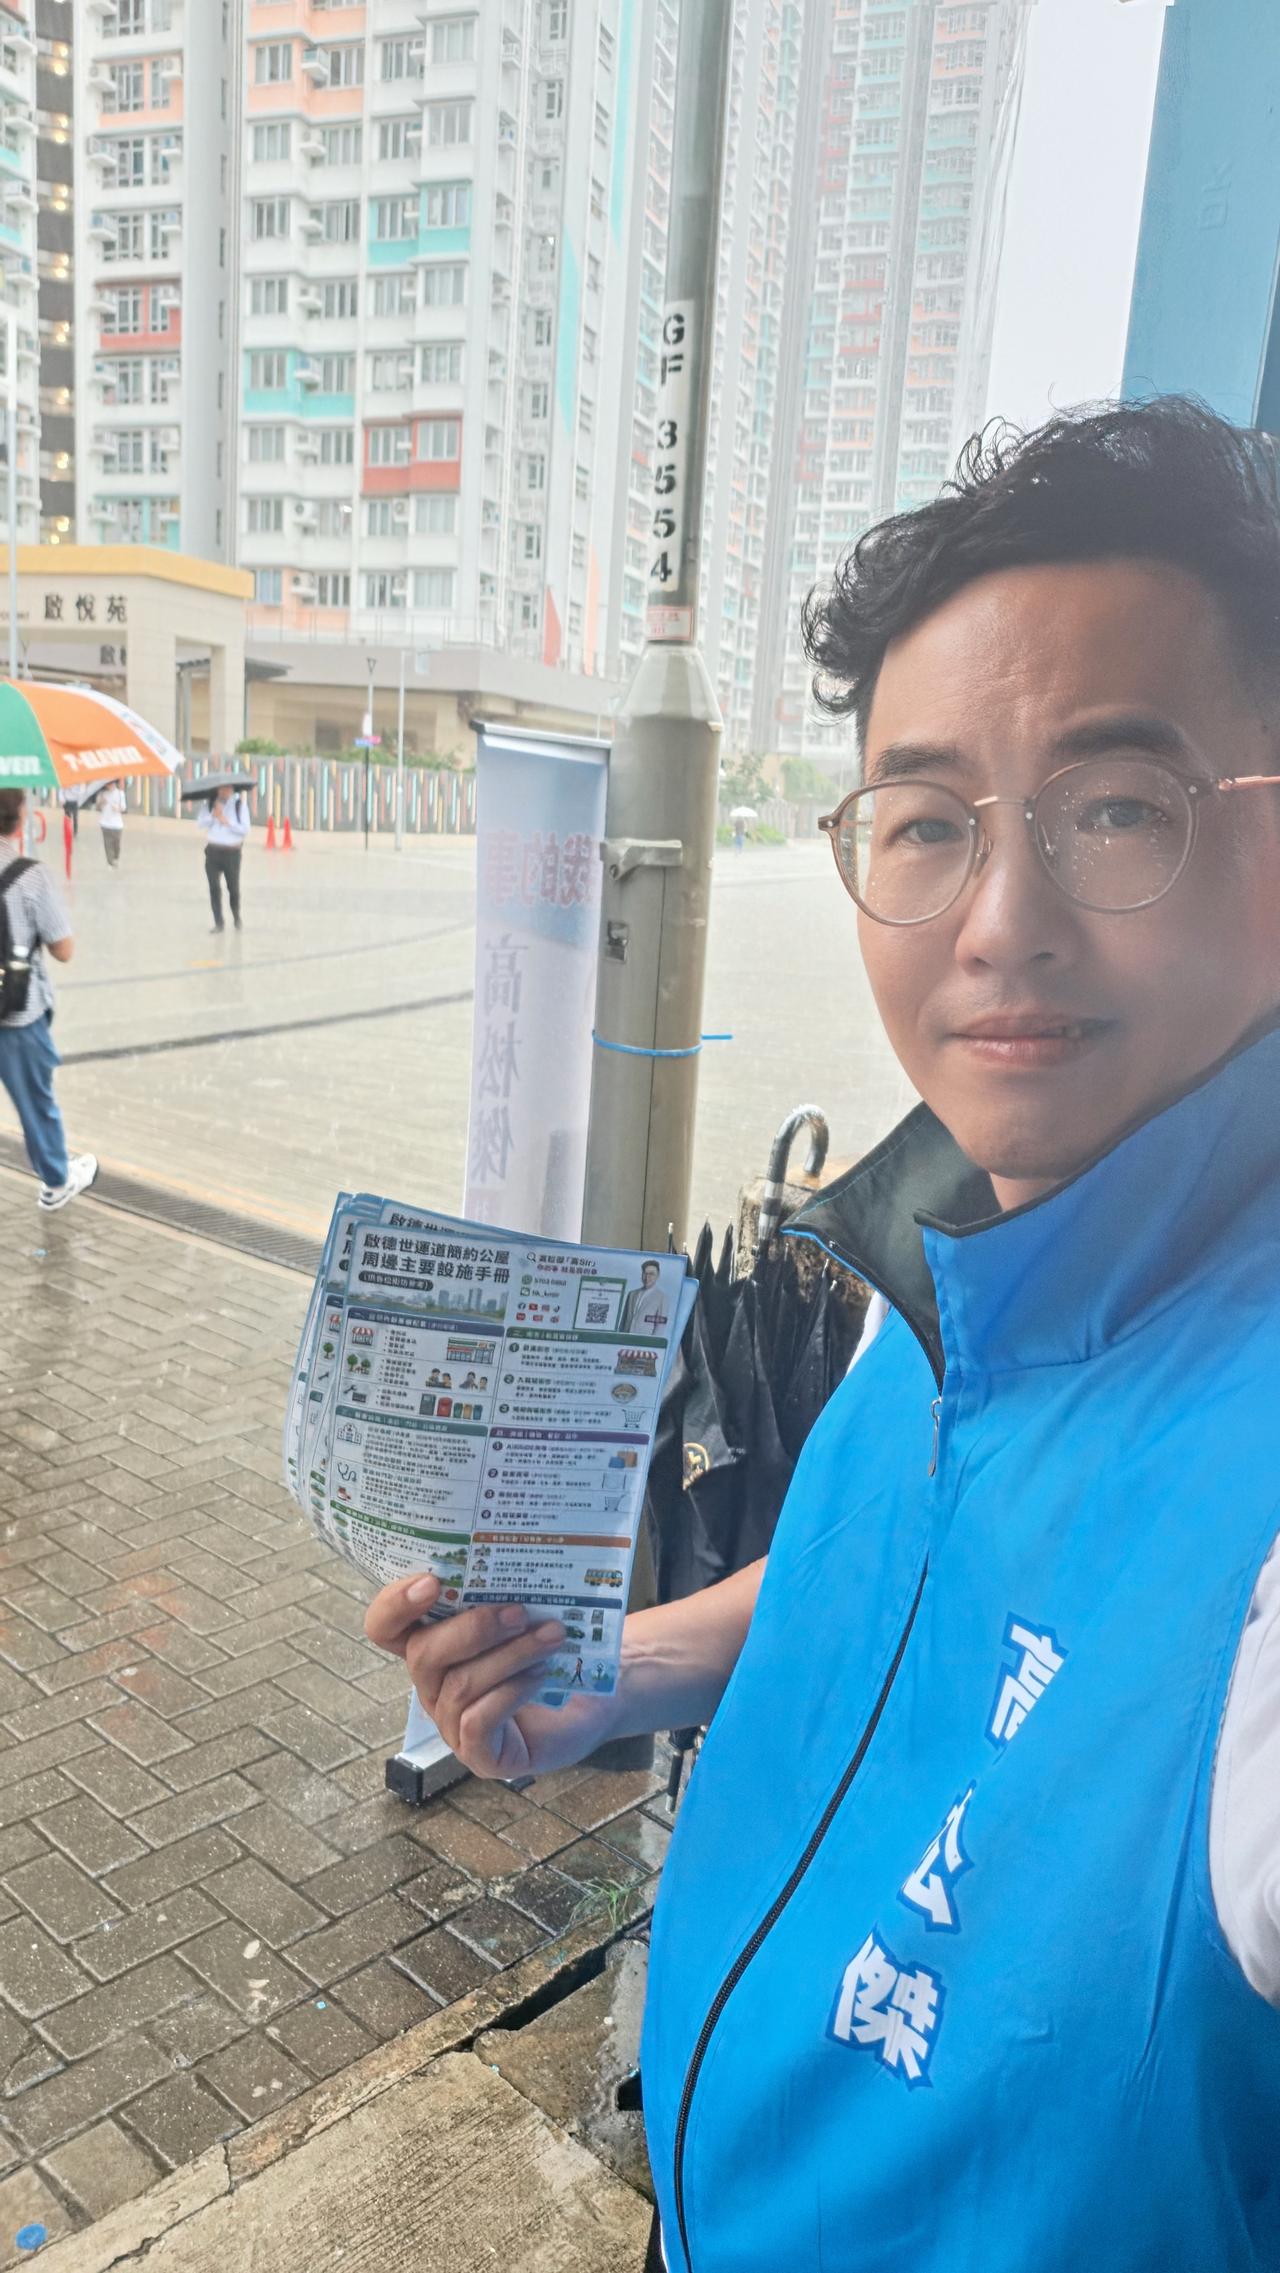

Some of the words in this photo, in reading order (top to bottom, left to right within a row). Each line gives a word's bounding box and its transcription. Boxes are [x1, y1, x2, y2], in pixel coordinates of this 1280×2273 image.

[660, 313, 686, 386] GF
[651, 420, 679, 583] 3554
[44, 593, 127, 623] 啟悅苑
[364, 1233, 510, 1265] 啟德世運道簡約公屋
[362, 1251, 510, 1284] 周邊主要設施手冊
